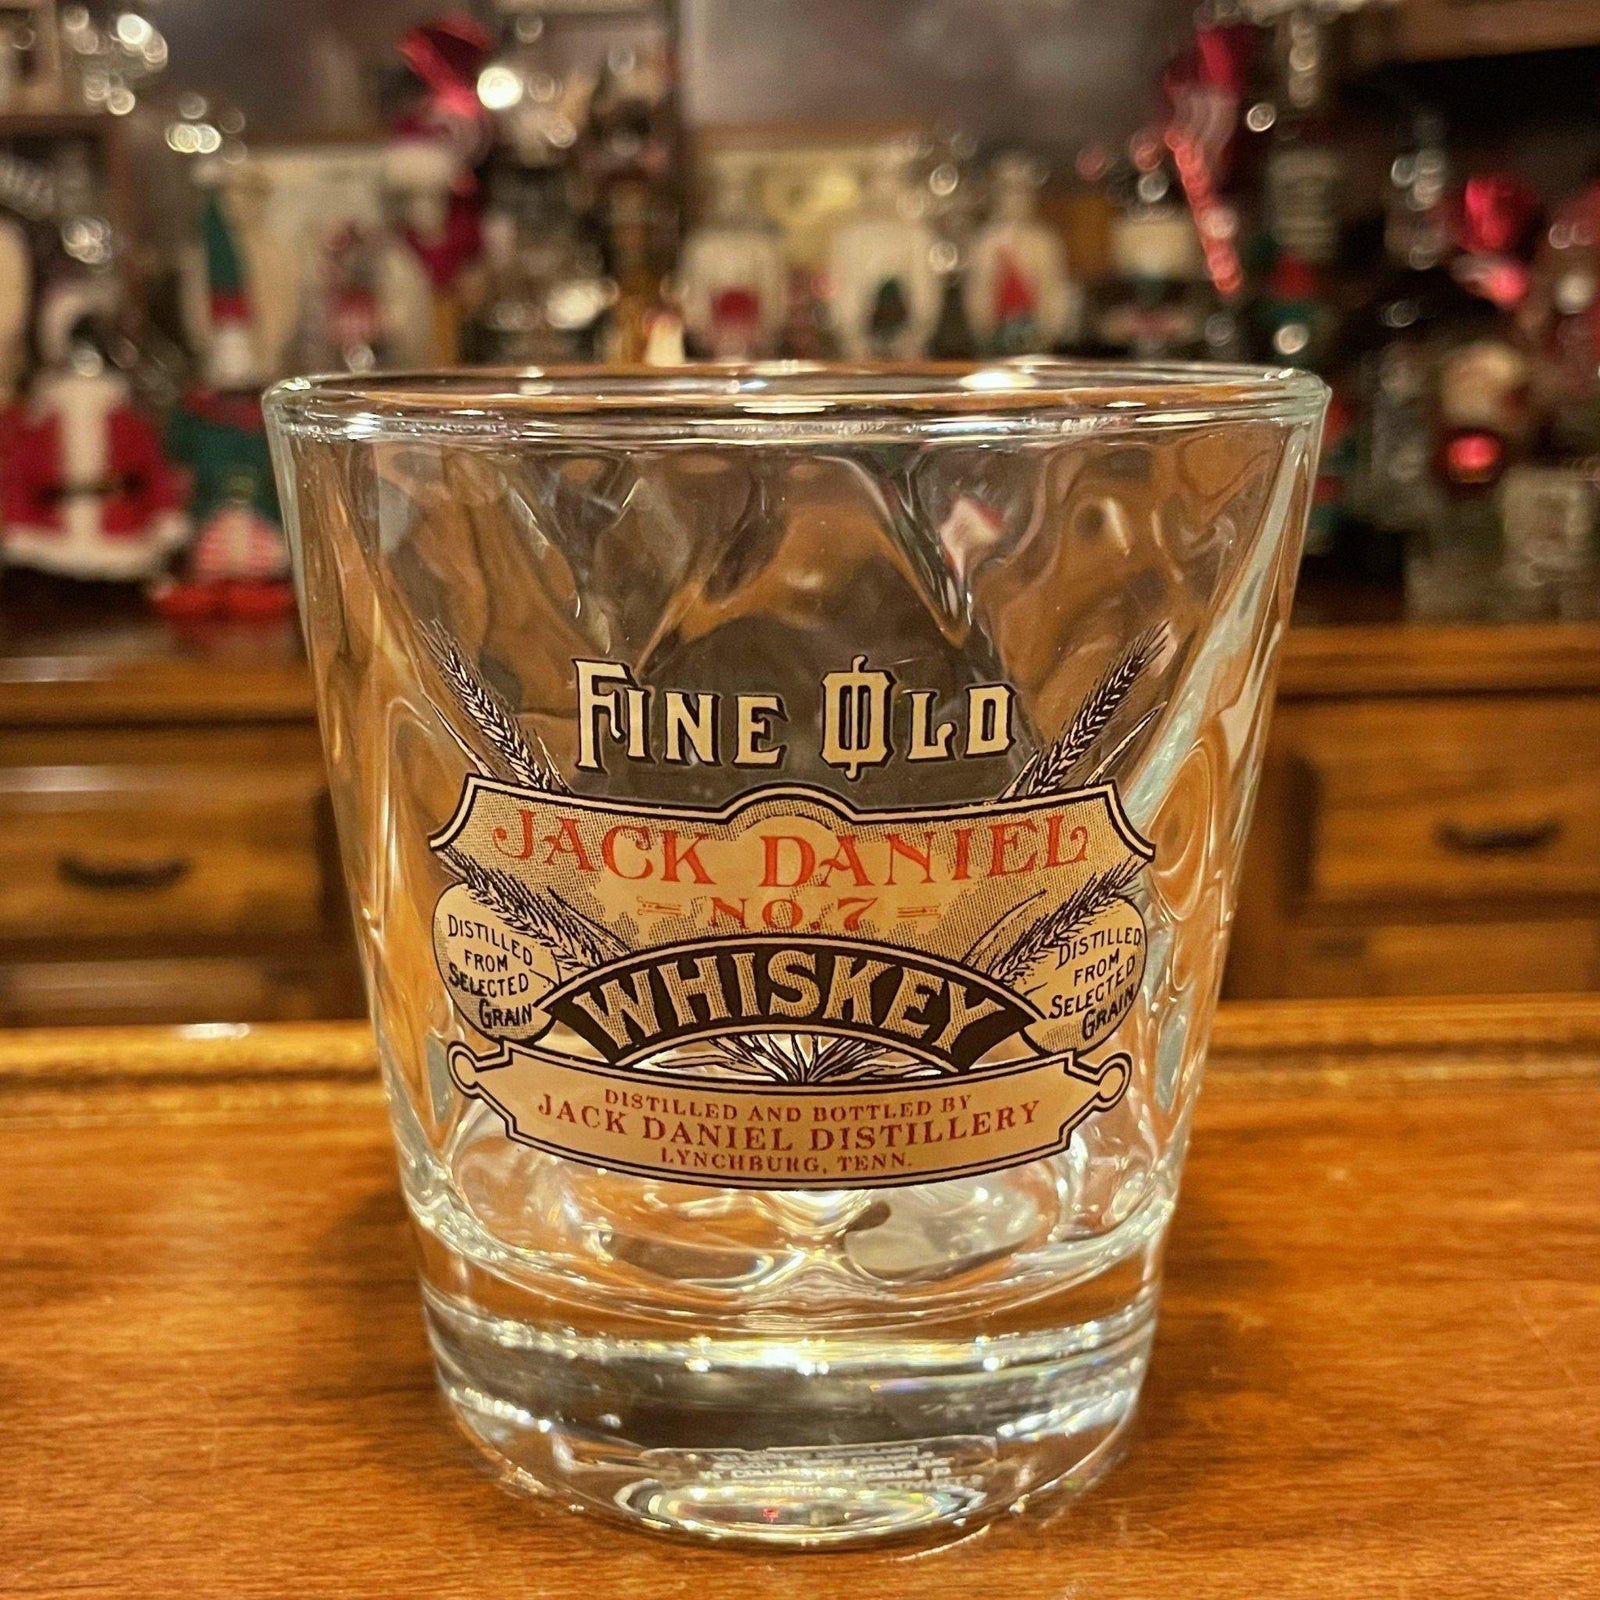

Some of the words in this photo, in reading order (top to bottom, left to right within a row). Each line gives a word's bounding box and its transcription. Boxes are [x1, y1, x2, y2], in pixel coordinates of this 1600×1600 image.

[572, 658, 788, 774] FINE
[819, 654, 1017, 783] OLD
[492, 808, 718, 885] JACK
[758, 813, 1088, 888] DANIEL
[447, 913, 533, 967] DISTILLED
[464, 949, 508, 973] FROM
[1055, 926, 1143, 971] DISTILLED
[448, 961, 529, 998] SELECTED
[1048, 953, 1136, 1019] SELECTED
[1073, 947, 1120, 987] FROM
[478, 998, 533, 1029] GRAIN
[572, 949, 1006, 1054] WHISKEY
[1081, 982, 1135, 1041] GRAIN
[537, 1093, 628, 1136] JACK
[642, 1115, 794, 1152] DANIEL
[808, 1100, 1041, 1152] DISTILLERY
[605, 1088, 738, 1121] DISTILLED
[747, 1105, 802, 1123] AND
[813, 1099, 933, 1123] BOTTLED
[940, 1094, 972, 1113] BY
[661, 1147, 828, 1174] LYNCHBURG,
[837, 1151, 914, 1173] TENN.
